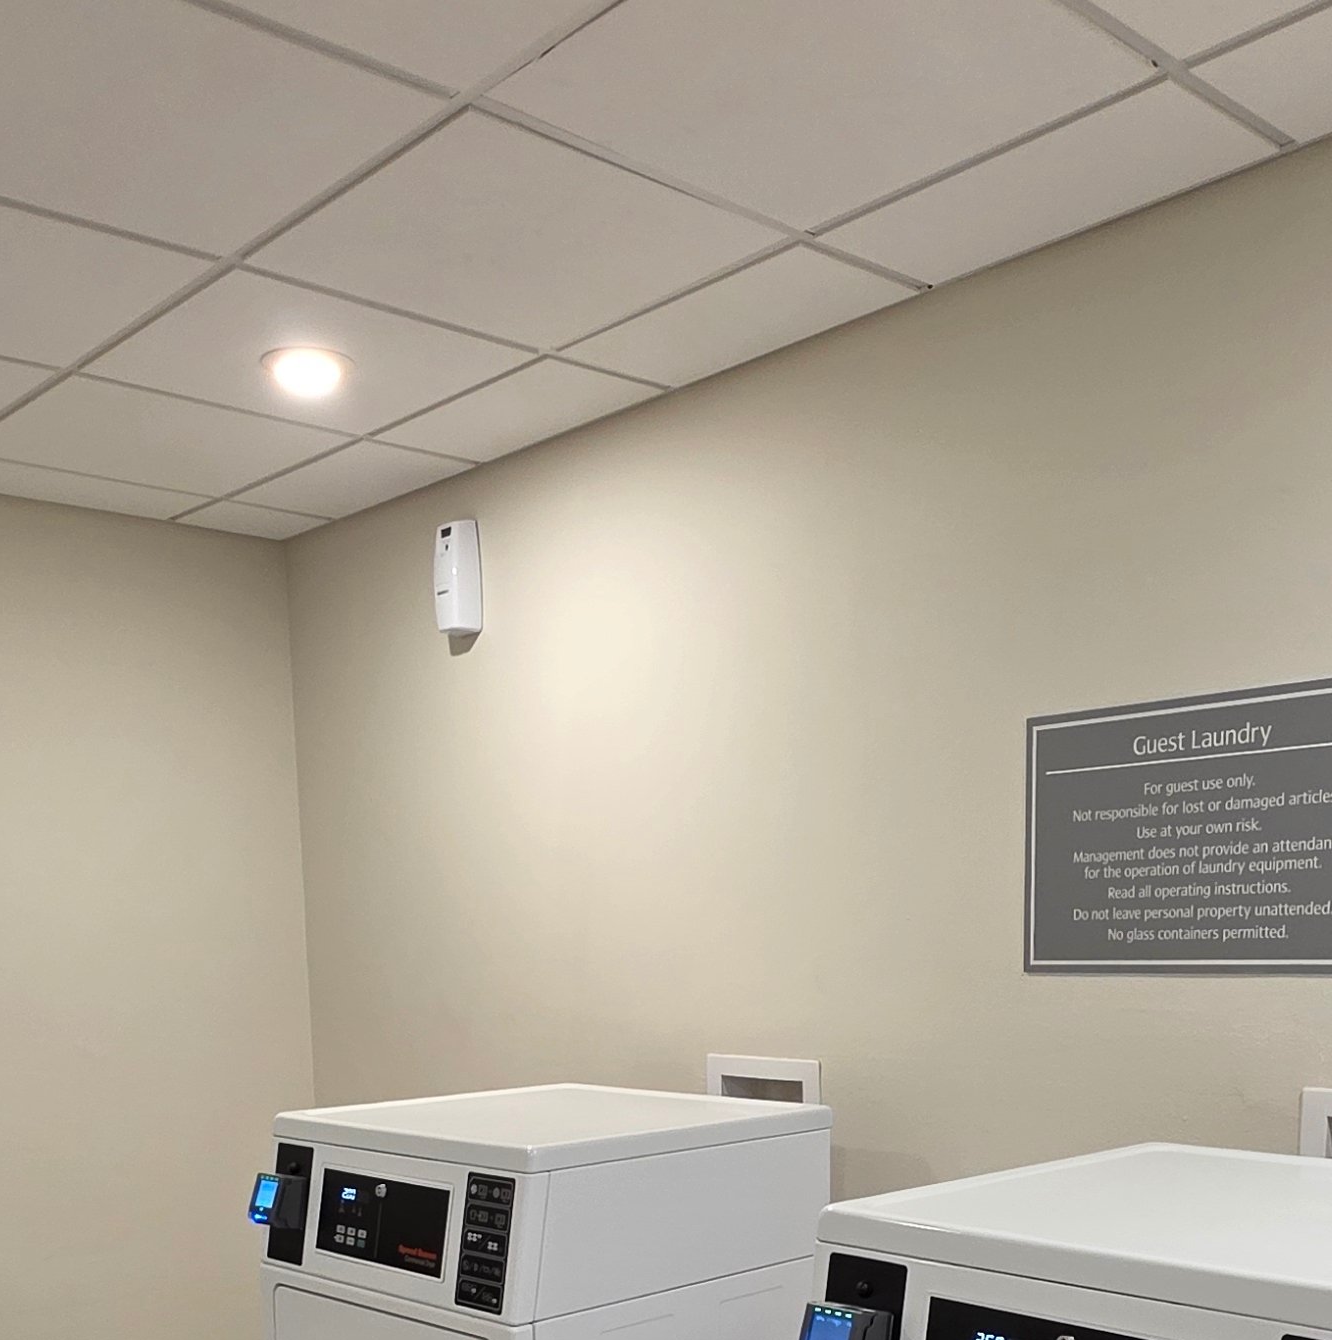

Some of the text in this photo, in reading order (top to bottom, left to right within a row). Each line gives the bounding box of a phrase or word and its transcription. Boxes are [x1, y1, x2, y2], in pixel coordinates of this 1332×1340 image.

[1133, 722, 1272, 756] Guest Laundry
[1144, 773, 1256, 796] For guest use only.
[1073, 809, 1092, 822] Not
[1095, 803, 1158, 821] responsible
[1162, 802, 1179, 815] for
[1182, 800, 1204, 814] lost
[1208, 800, 1221, 812] or
[1225, 792, 1284, 810] damaged
[1137, 818, 1262, 839] Use at your own risk.
[1073, 848, 1144, 864] Management
[1148, 847, 1175, 859] does
[1179, 845, 1199, 857] not
[1202, 841, 1249, 859] provide
[1252, 842, 1268, 854] an
[1084, 856, 1322, 879] for the operation of laundry equipment.
[1108, 880, 1291, 900] Read all operating instructions.
[1073, 900, 1332, 922] Do not leave personal property unattended.
[1108, 924, 1289, 943] No glass containers permitted.
